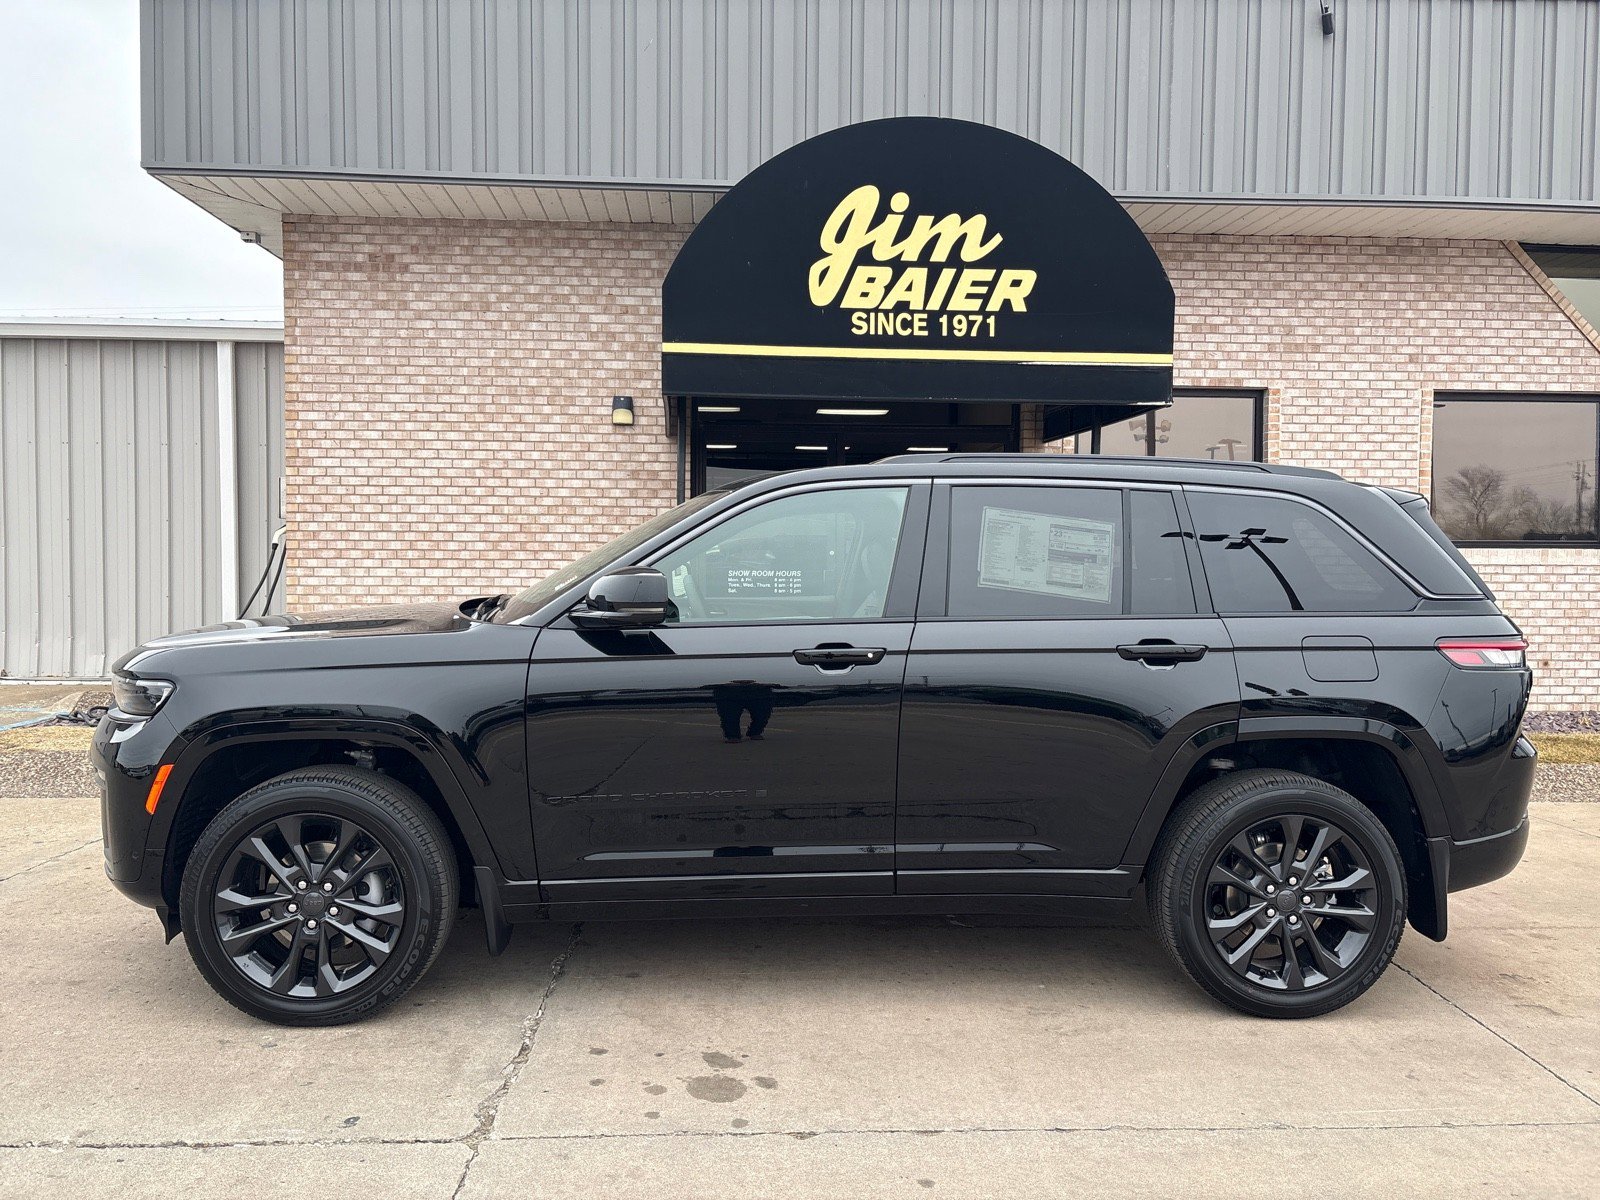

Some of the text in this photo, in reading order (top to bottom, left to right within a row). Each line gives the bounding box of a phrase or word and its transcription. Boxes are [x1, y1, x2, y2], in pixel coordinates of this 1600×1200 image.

[808, 184, 1003, 306] Jim
[839, 265, 1037, 312] BAIER
[851, 311, 996, 337] SINCE 1971
